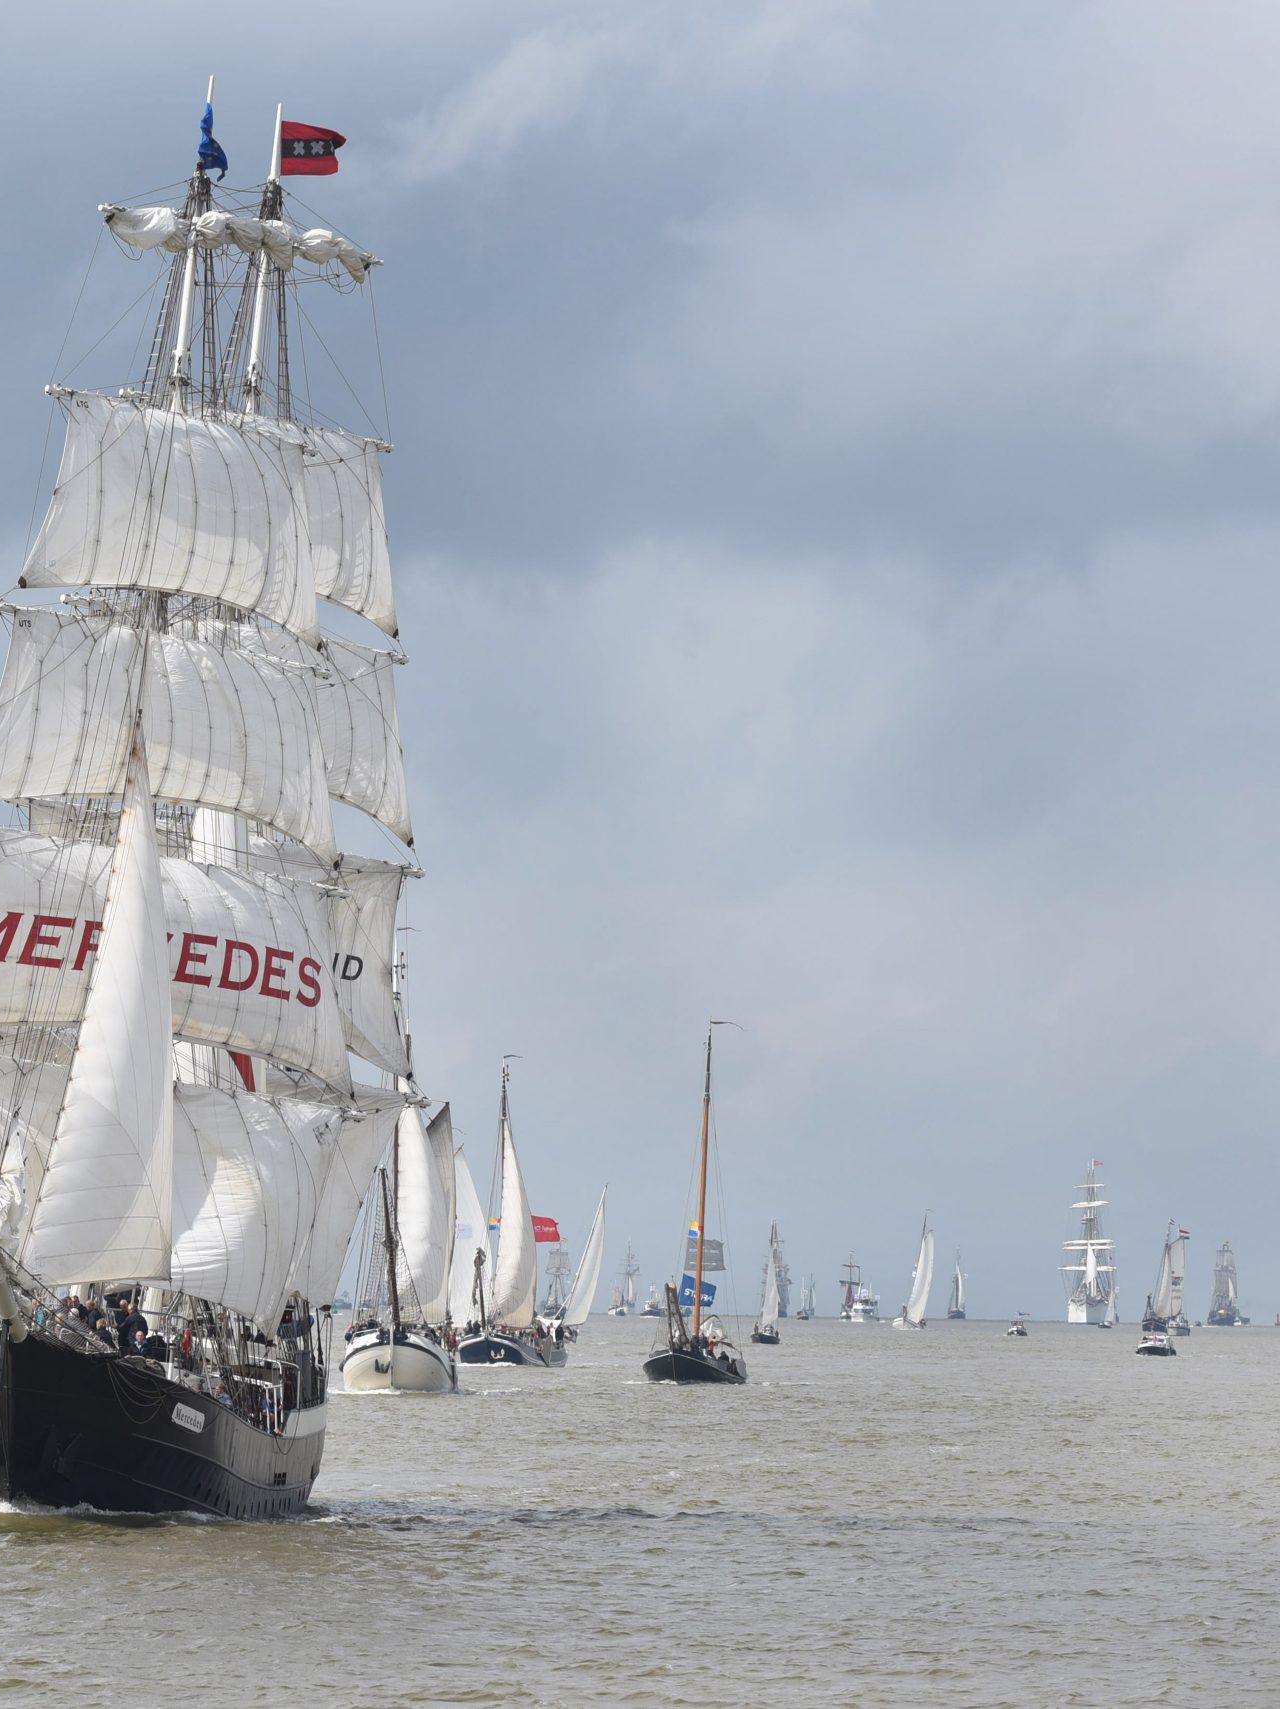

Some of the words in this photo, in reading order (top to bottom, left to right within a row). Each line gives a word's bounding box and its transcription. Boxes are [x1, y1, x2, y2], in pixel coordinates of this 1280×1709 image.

[76, 400, 89, 408] LTG
[18, 619, 32, 628] UTS
[683, 1288, 713, 1302] STRK
[175, 1406, 202, 1430] Mercedes
